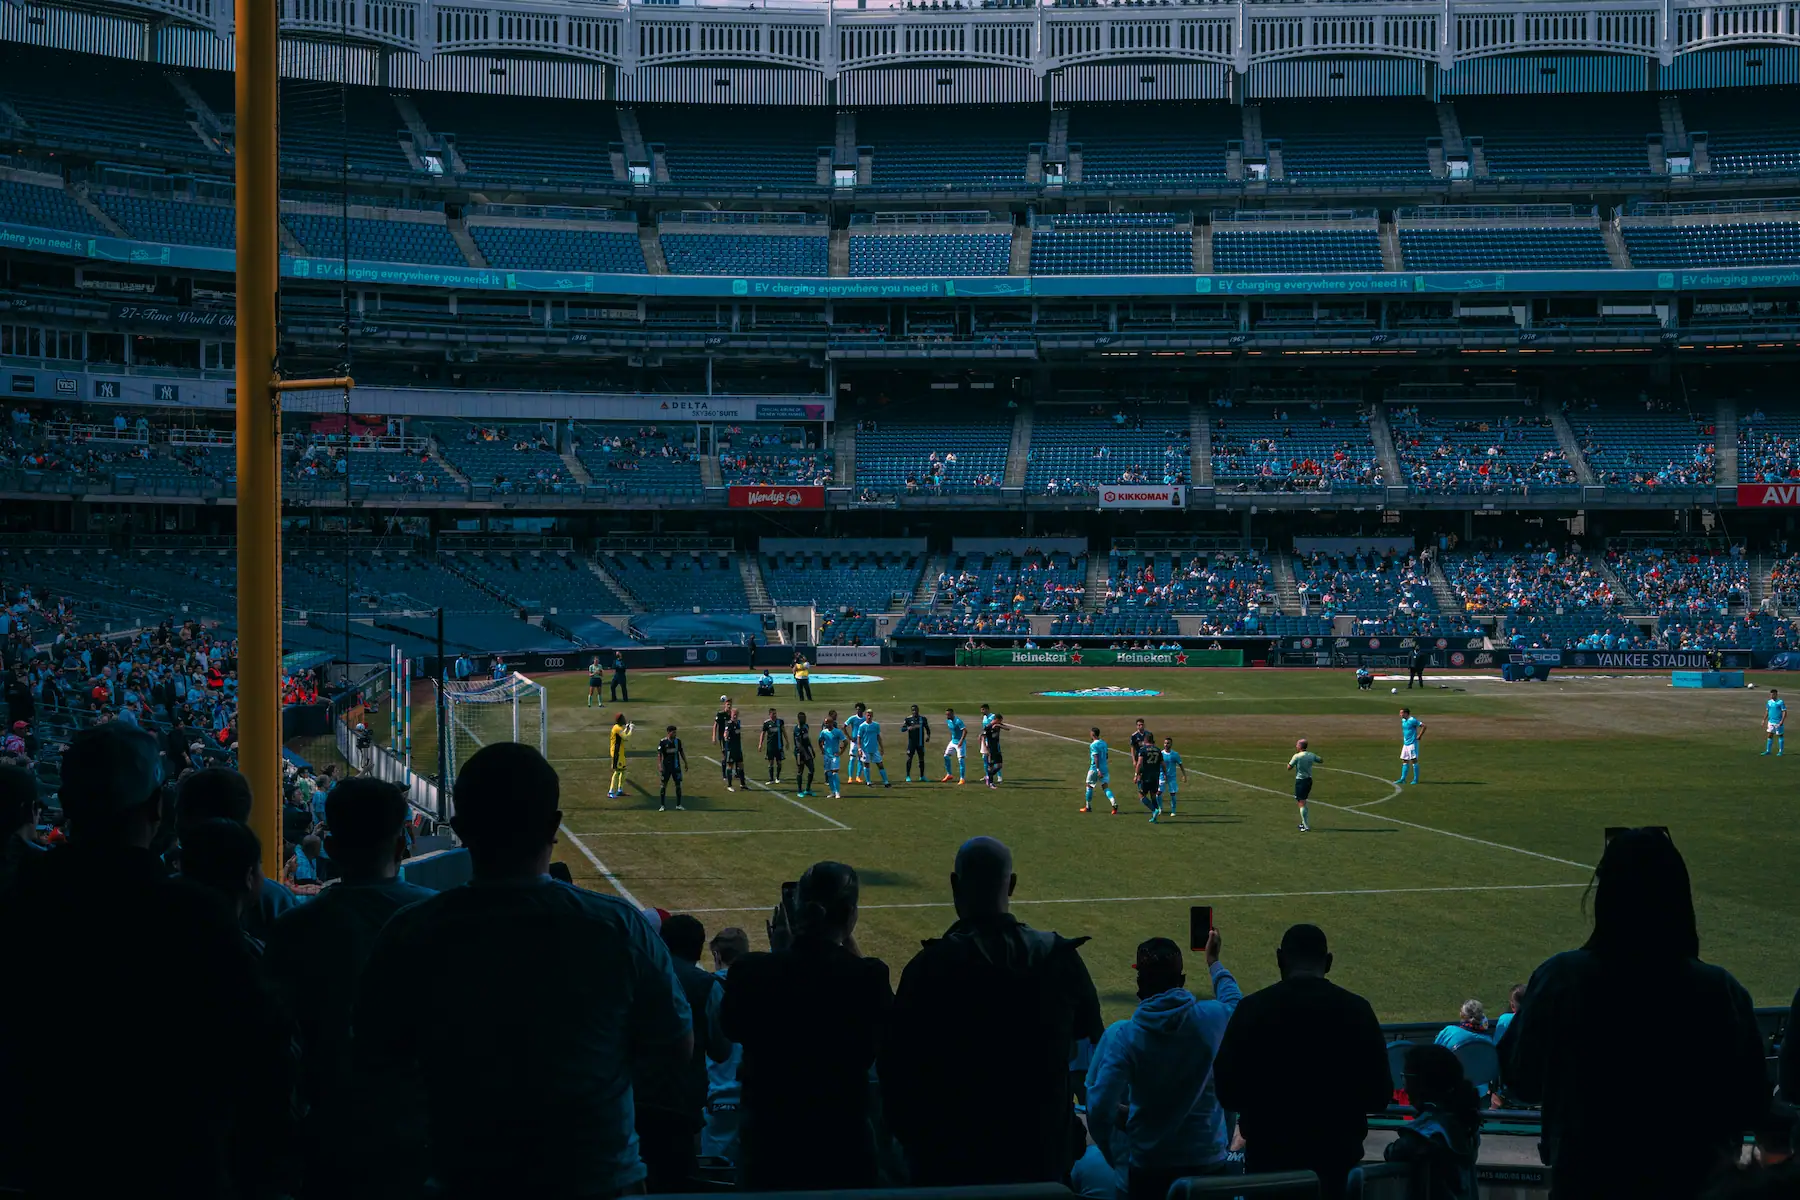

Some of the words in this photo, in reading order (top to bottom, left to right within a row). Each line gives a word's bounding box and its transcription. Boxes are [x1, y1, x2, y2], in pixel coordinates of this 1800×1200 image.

[28, 236, 46, 246] you
[49, 239, 73, 249] need
[316, 264, 332, 274] EV
[334, 264, 378, 280] charging
[381, 268, 440, 283] everywhere
[443, 274, 461, 285] you
[464, 274, 489, 285] need
[492, 273, 500, 285] it
[1682, 275, 1698, 285] EV
[1700, 274, 1748, 286] charging
[755, 283, 770, 293] EV
[772, 283, 815, 295] charging
[818, 283, 879, 296] everywhere
[881, 285, 901, 295] you
[903, 283, 929, 293] need
[931, 283, 938, 292] it
[1218, 280, 1233, 290] EV
[1236, 280, 1280, 292] charging
[1283, 279, 1346, 292] everywhere
[1348, 280, 1368, 291] you
[1371, 278, 1397, 289] need
[1400, 278, 1408, 288] it
[118, 306, 173, 321] 27-Time
[177, 311, 218, 325] World
[60, 381, 74, 389] YES
[748, 489, 785, 505] Wendy's
[1012, 652, 1067, 662] Heineken
[1116, 652, 1172, 663] Heineken
[1530, 653, 1560, 661] EICO
[1597, 653, 1649, 666] YANKEE
[1147, 752, 1159, 764] 27
[1521, 1173, 1542, 1181] BALLS
